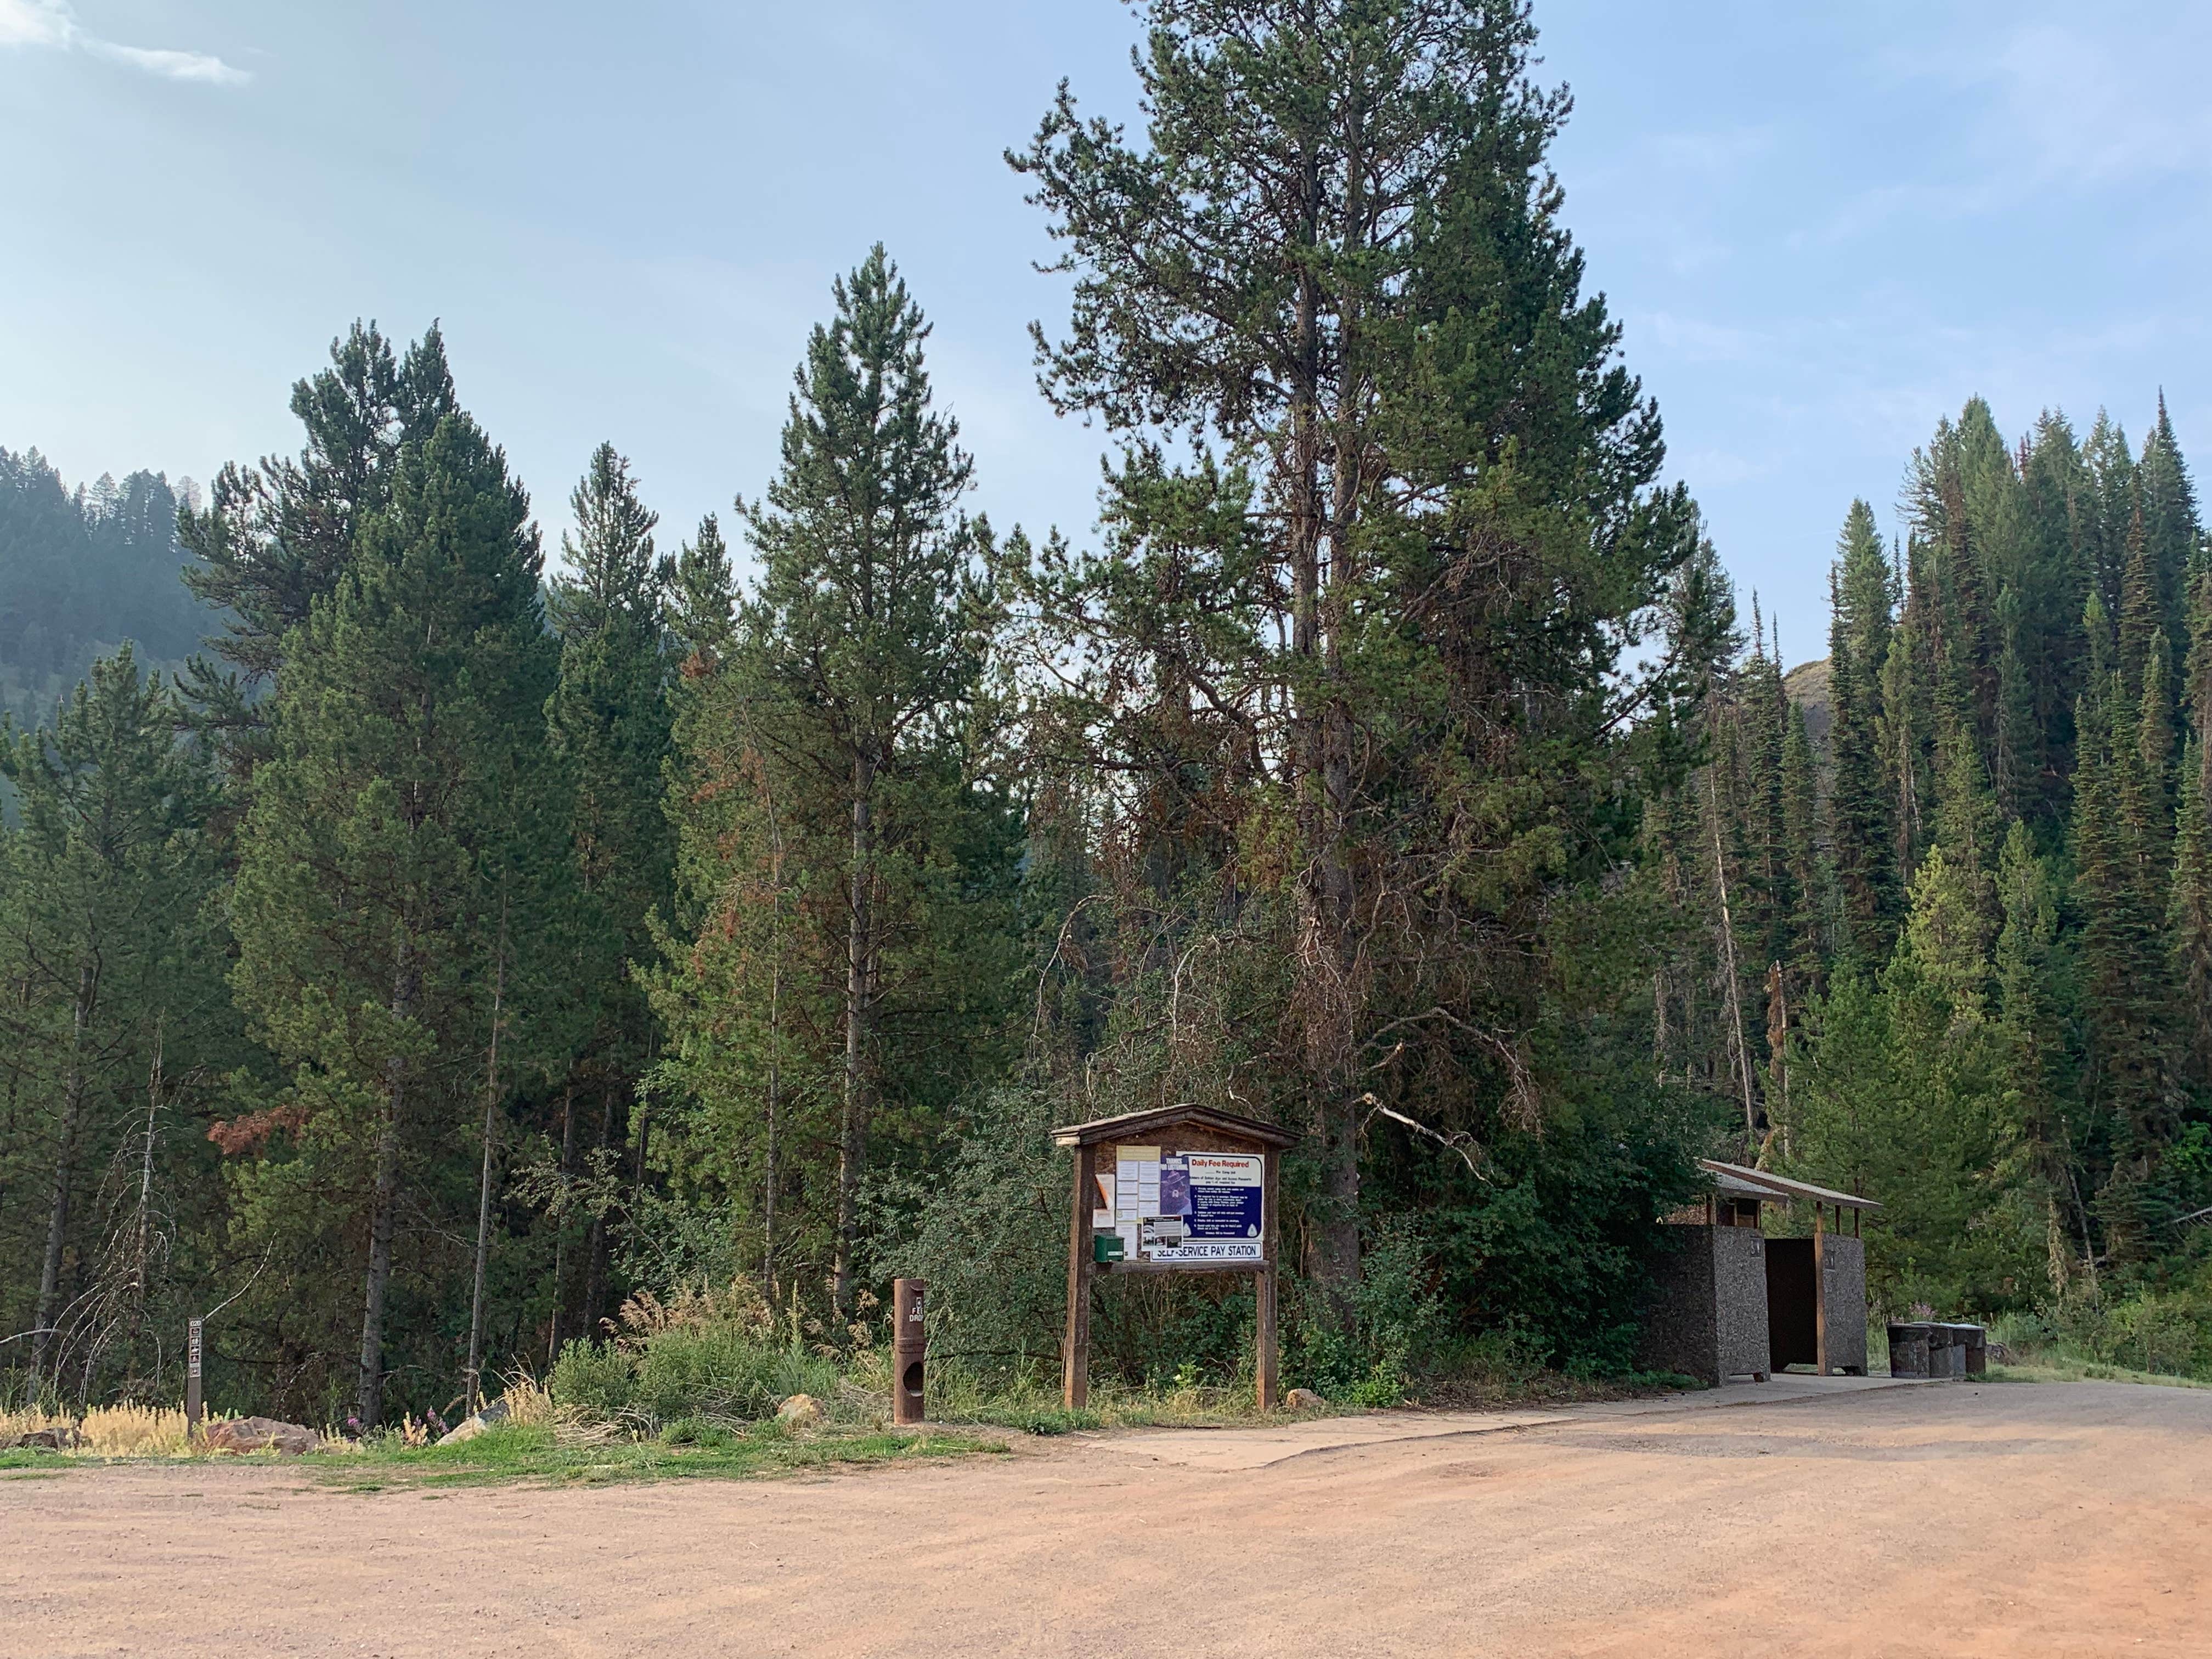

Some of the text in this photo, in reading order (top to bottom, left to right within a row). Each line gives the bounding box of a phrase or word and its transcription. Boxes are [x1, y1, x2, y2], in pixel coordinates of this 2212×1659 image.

[1192, 1159, 1207, 1167] Daily
[1222, 1160, 1249, 1169] Required
[1211, 1246, 1226, 1256] PAY
[1228, 1245, 1256, 1256] STATION
